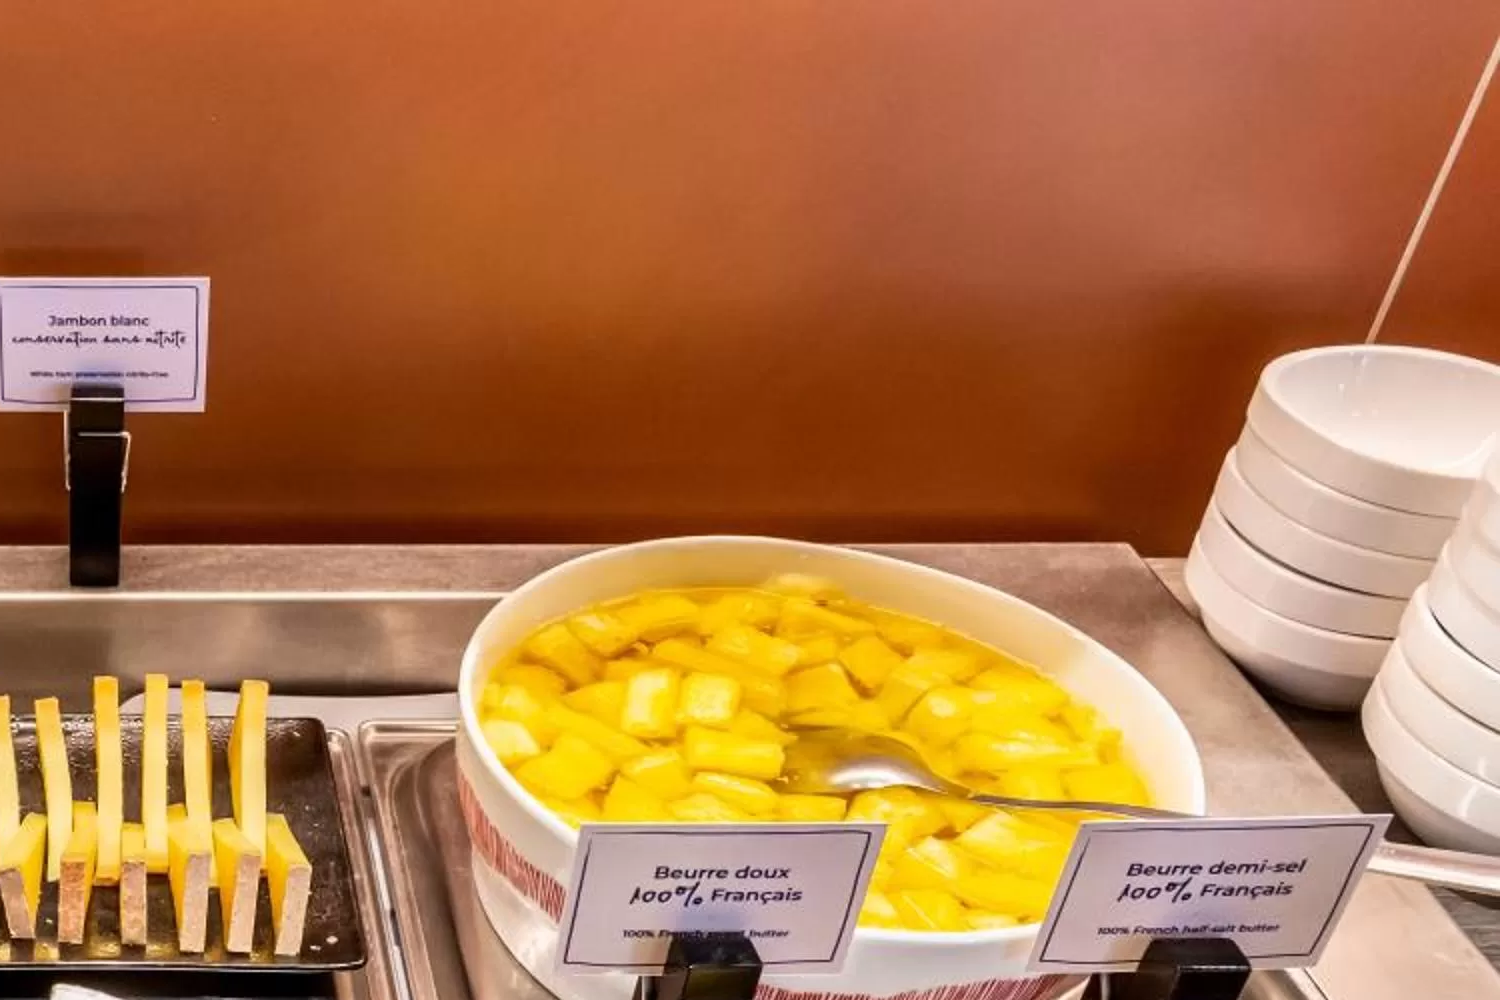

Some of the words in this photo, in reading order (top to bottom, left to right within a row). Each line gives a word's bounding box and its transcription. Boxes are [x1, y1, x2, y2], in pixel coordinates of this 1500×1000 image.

[47, 314, 107, 327] Jambon
[110, 314, 150, 327] blanc
[11, 331, 98, 348] conservation
[145, 329, 187, 348] nitrite
[654, 865, 729, 880] Beurre
[735, 865, 791, 880] doux
[1126, 862, 1203, 877] Beurre
[1209, 858, 1307, 875] demi-sel
[629, 882, 704, 908] 100%
[711, 887, 802, 905] Français
[1117, 876, 1193, 904] 100%
[1200, 881, 1293, 900] Français
[623, 929, 655, 938] 100%
[748, 929, 790, 938] butter
[1098, 926, 1130, 936] 100%
[1134, 925, 1180, 936] French
[1238, 924, 1281, 934] butter
